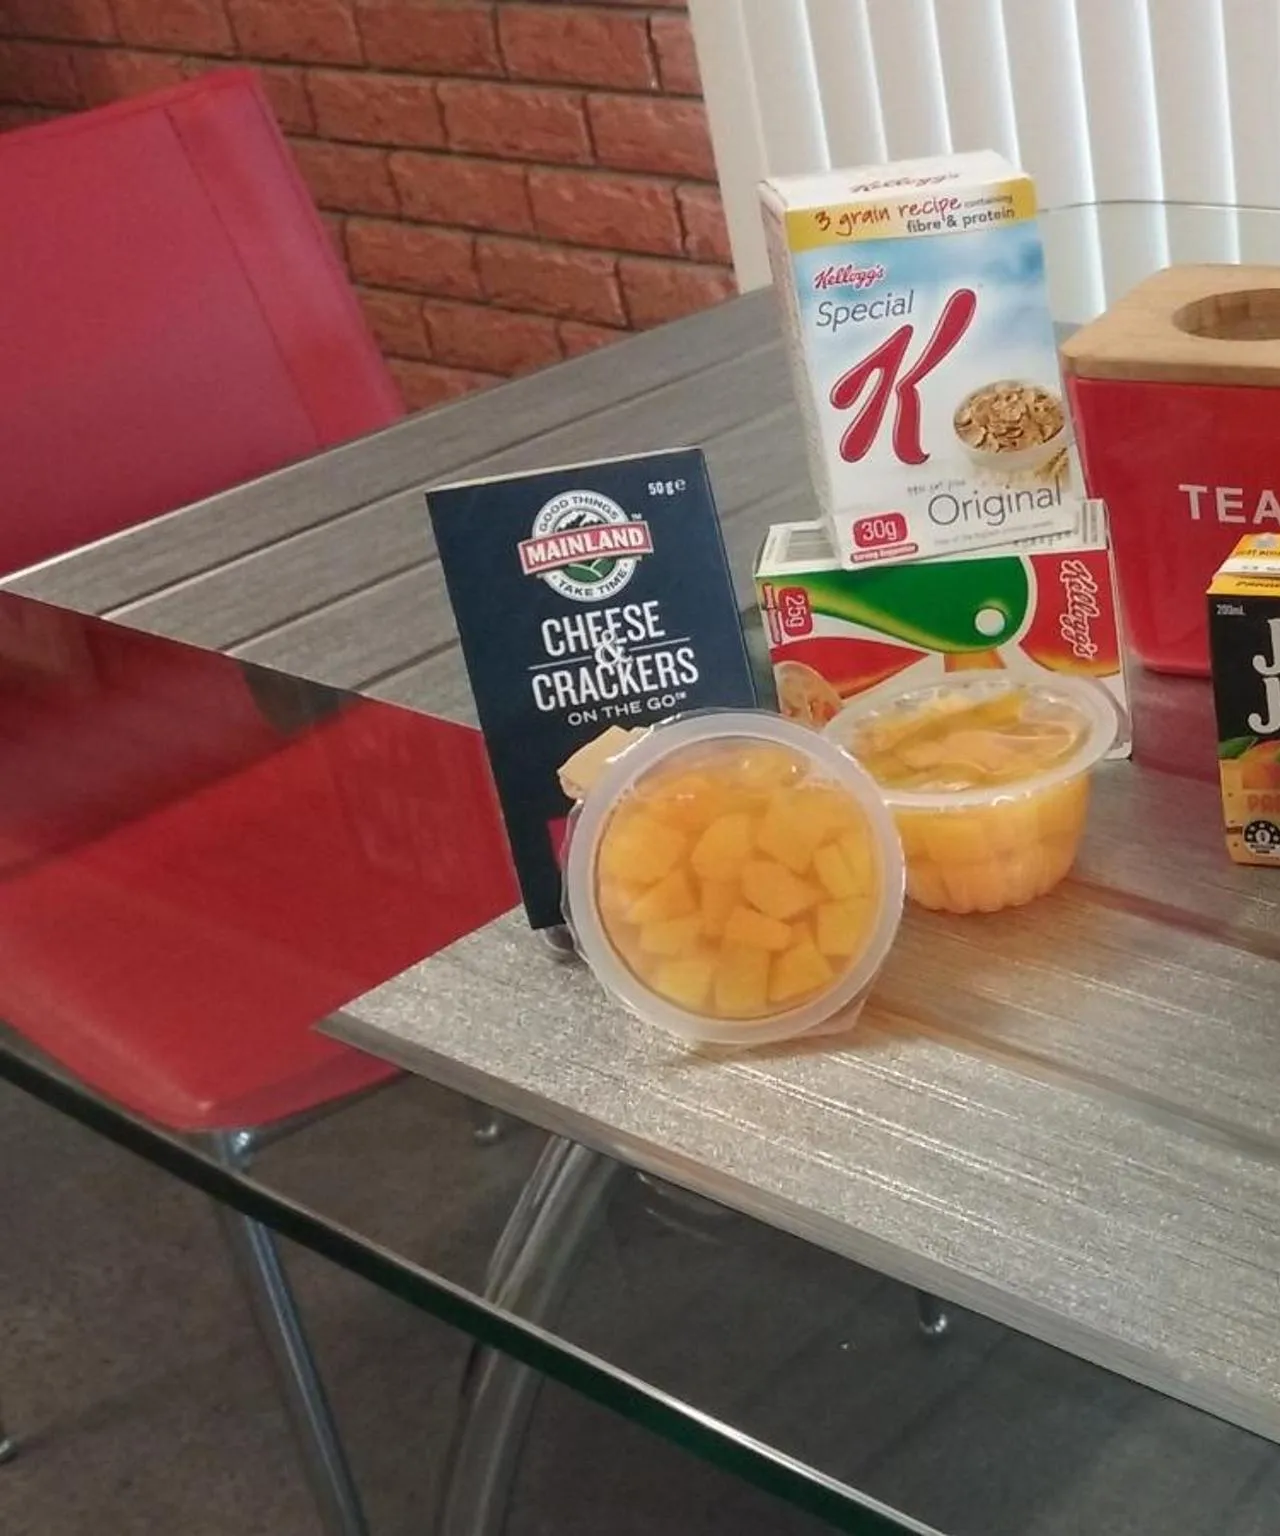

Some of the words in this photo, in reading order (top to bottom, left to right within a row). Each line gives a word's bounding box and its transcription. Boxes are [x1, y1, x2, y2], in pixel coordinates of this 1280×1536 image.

[814, 210, 831, 232] 3
[836, 205, 891, 237] grain
[898, 196, 961, 222] recipe
[906, 216, 942, 234] fibre
[946, 214, 958, 229] &
[962, 207, 1016, 230] protein
[813, 264, 885, 291] Kellogg's
[815, 290, 915, 332] Special
[828, 287, 978, 466] K
[539, 499, 570, 533] GOOD
[571, 496, 619, 521] THINGS
[928, 475, 1062, 527] Original
[526, 527, 646, 566] MAINLAND
[860, 518, 898, 542] 30g
[557, 579, 594, 597] TAKE
[598, 570, 628, 593] TIME
[540, 600, 667, 657] CHEESE
[785, 594, 807, 628] 25g
[1059, 559, 1101, 661] Kellogg's
[1216, 604, 1247, 616] 200mL
[594, 629, 633, 668] &
[531, 647, 699, 712] CRACKERS
[567, 708, 598, 727] ON
[601, 700, 643, 720] THE
